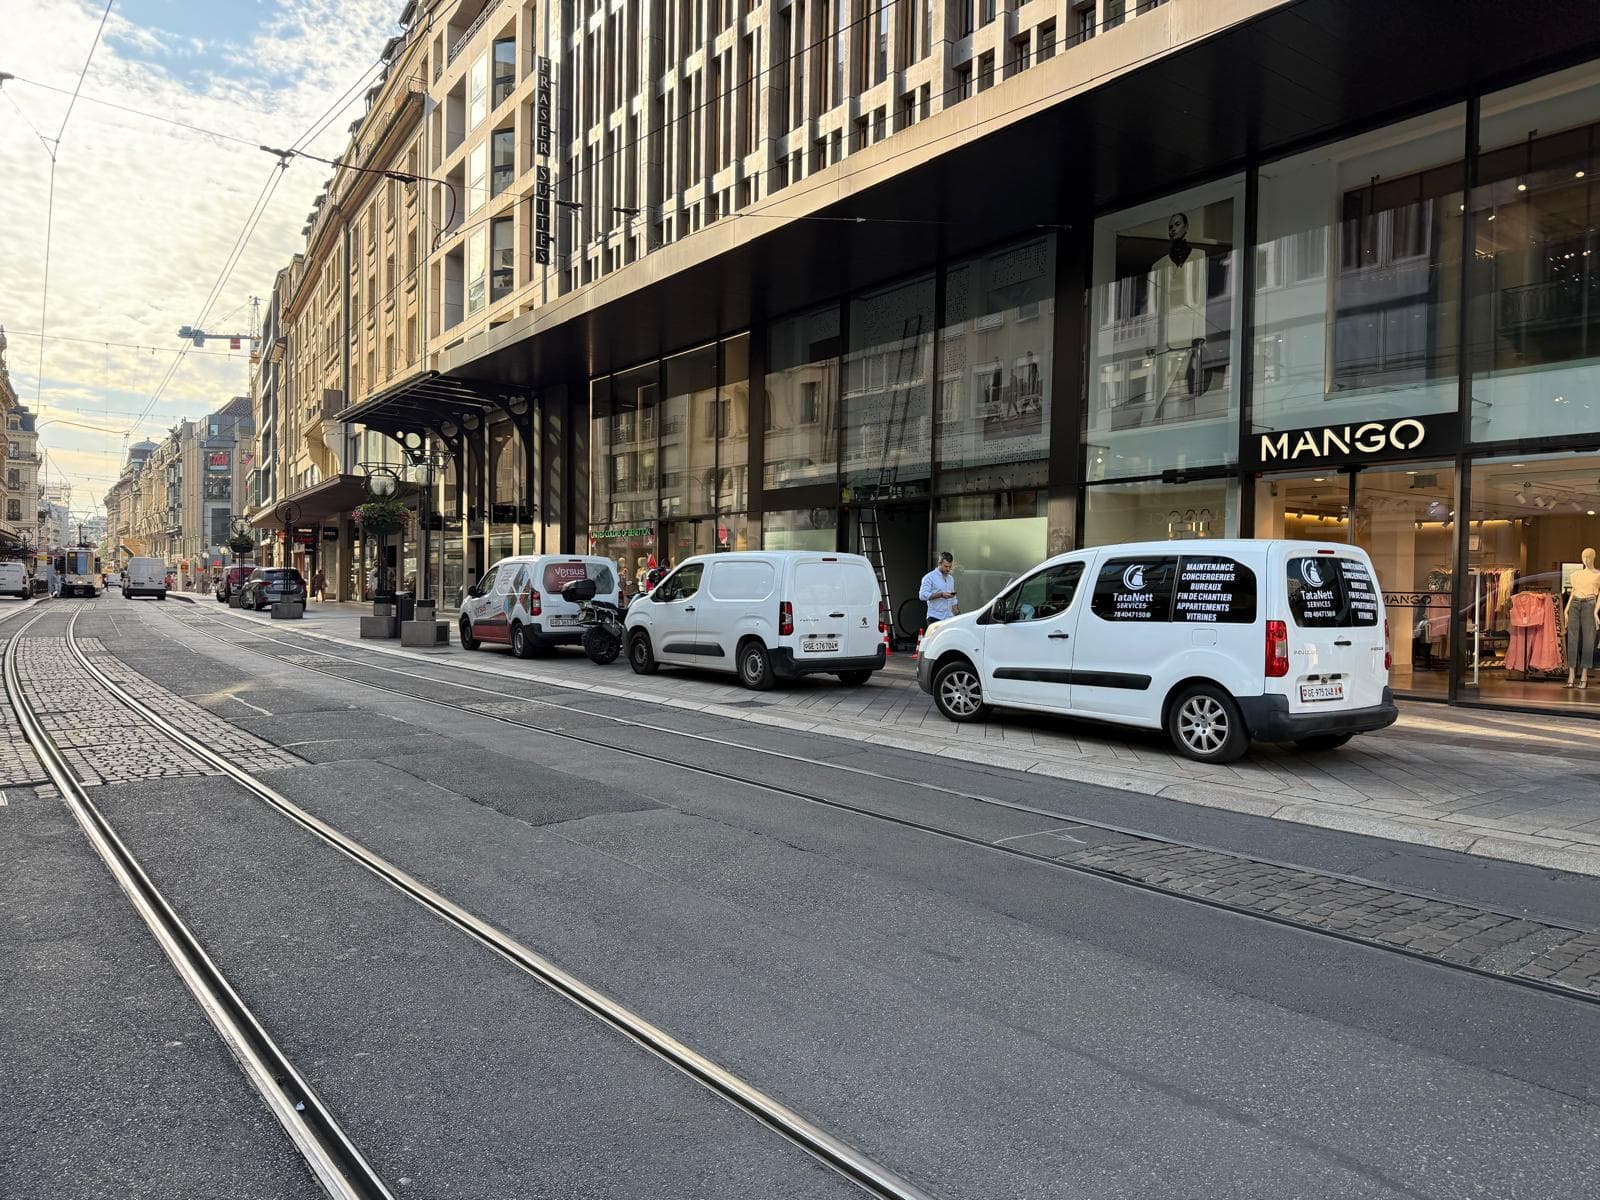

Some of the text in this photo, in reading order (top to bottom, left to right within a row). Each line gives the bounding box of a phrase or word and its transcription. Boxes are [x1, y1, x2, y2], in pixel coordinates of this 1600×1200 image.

[538, 58, 549, 263] FRASER SUITES
[1260, 418, 1425, 462] MANGO
[1186, 563, 1234, 572] MAINTENANCE
[1181, 573, 1235, 581] CONCIERGERIES
[1190, 583, 1222, 591] BUREAUX
[1113, 592, 1153, 602] TataNett
[1177, 592, 1232, 601] FIN DE CHANTIER
[1300, 590, 1334, 600] TataNett
[1176, 602, 1230, 611] APPARTEMENTS
[1186, 613, 1217, 621] VITRINES
